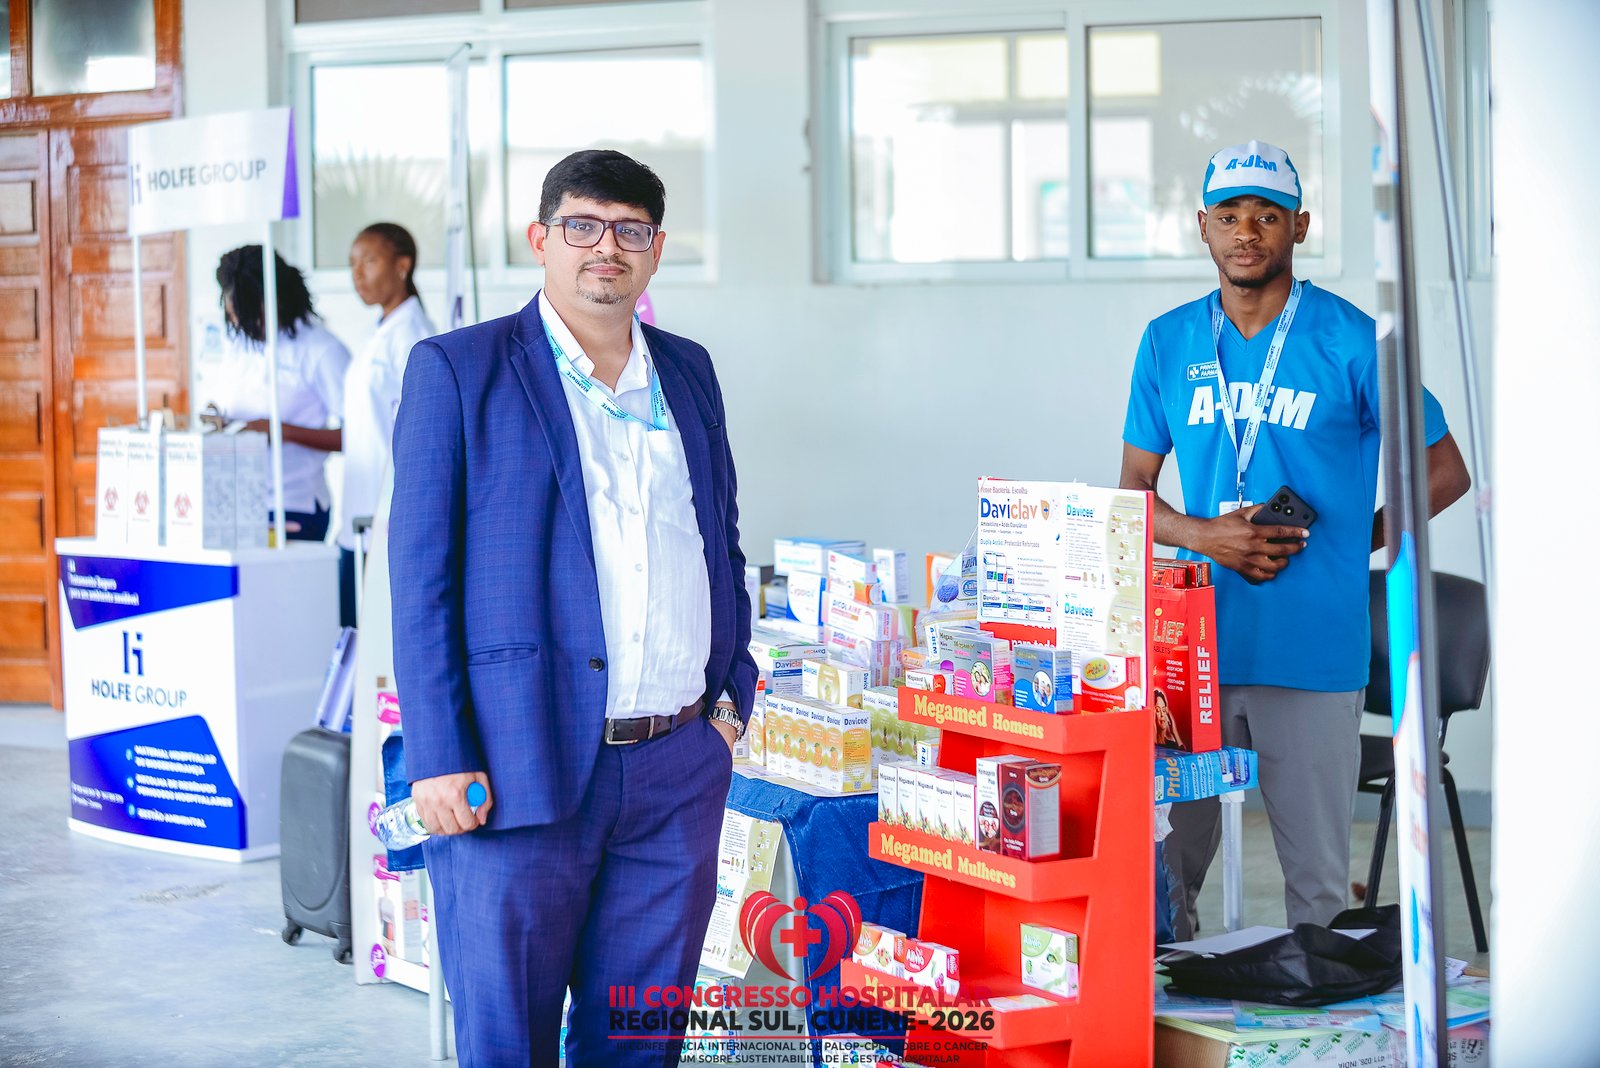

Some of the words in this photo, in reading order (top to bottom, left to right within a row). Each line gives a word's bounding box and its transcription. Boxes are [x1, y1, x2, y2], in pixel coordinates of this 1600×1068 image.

[1225, 154, 1278, 172] A-DEM
[147, 164, 197, 191] HOLFE
[199, 159, 267, 186] GROUP
[980, 498, 1038, 520] Daviclav
[1066, 504, 1094, 518] Davicee
[1064, 602, 1094, 618] Davicee
[1153, 618, 1184, 644] LIEF
[1154, 645, 1171, 654] ABLETS
[775, 661, 802, 669] Davicla
[91, 678, 132, 702] HOLFE
[135, 686, 187, 708] GROUP
[1197, 646, 1213, 724] RELIEF
[844, 717, 869, 726] Davicee
[914, 694, 987, 728] Megamed
[992, 712, 1044, 739] Homens
[899, 776, 915, 786] Megamed
[918, 780, 934, 790] Megamed
[1166, 756, 1180, 798] Pride
[880, 833, 953, 871] Megamed
[958, 856, 1016, 889] Mulheres
